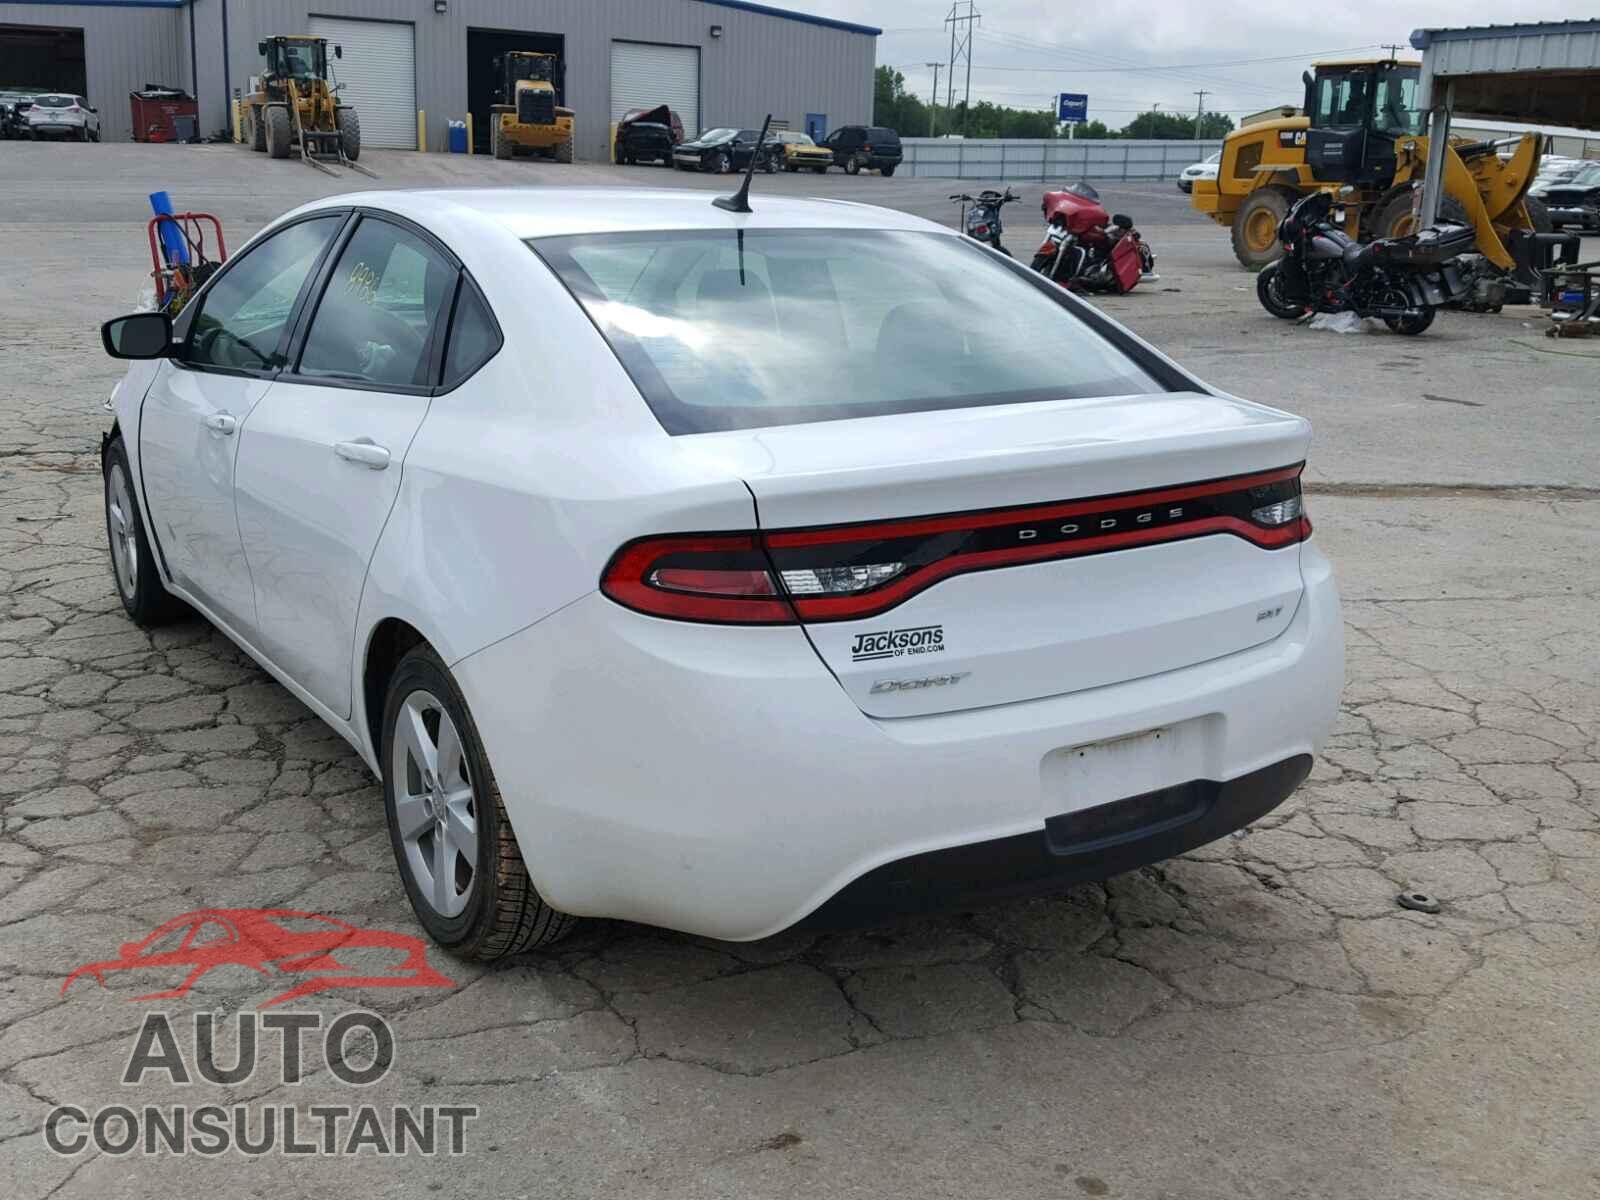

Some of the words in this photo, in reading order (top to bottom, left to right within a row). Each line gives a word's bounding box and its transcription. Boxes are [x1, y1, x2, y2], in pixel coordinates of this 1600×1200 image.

[1295, 131, 1306, 145] CA
[1018, 507, 1183, 540] DODGE
[852, 630, 944, 654] Jacksons
[894, 649, 905, 657] OF
[907, 643, 945, 656] ENID.COM
